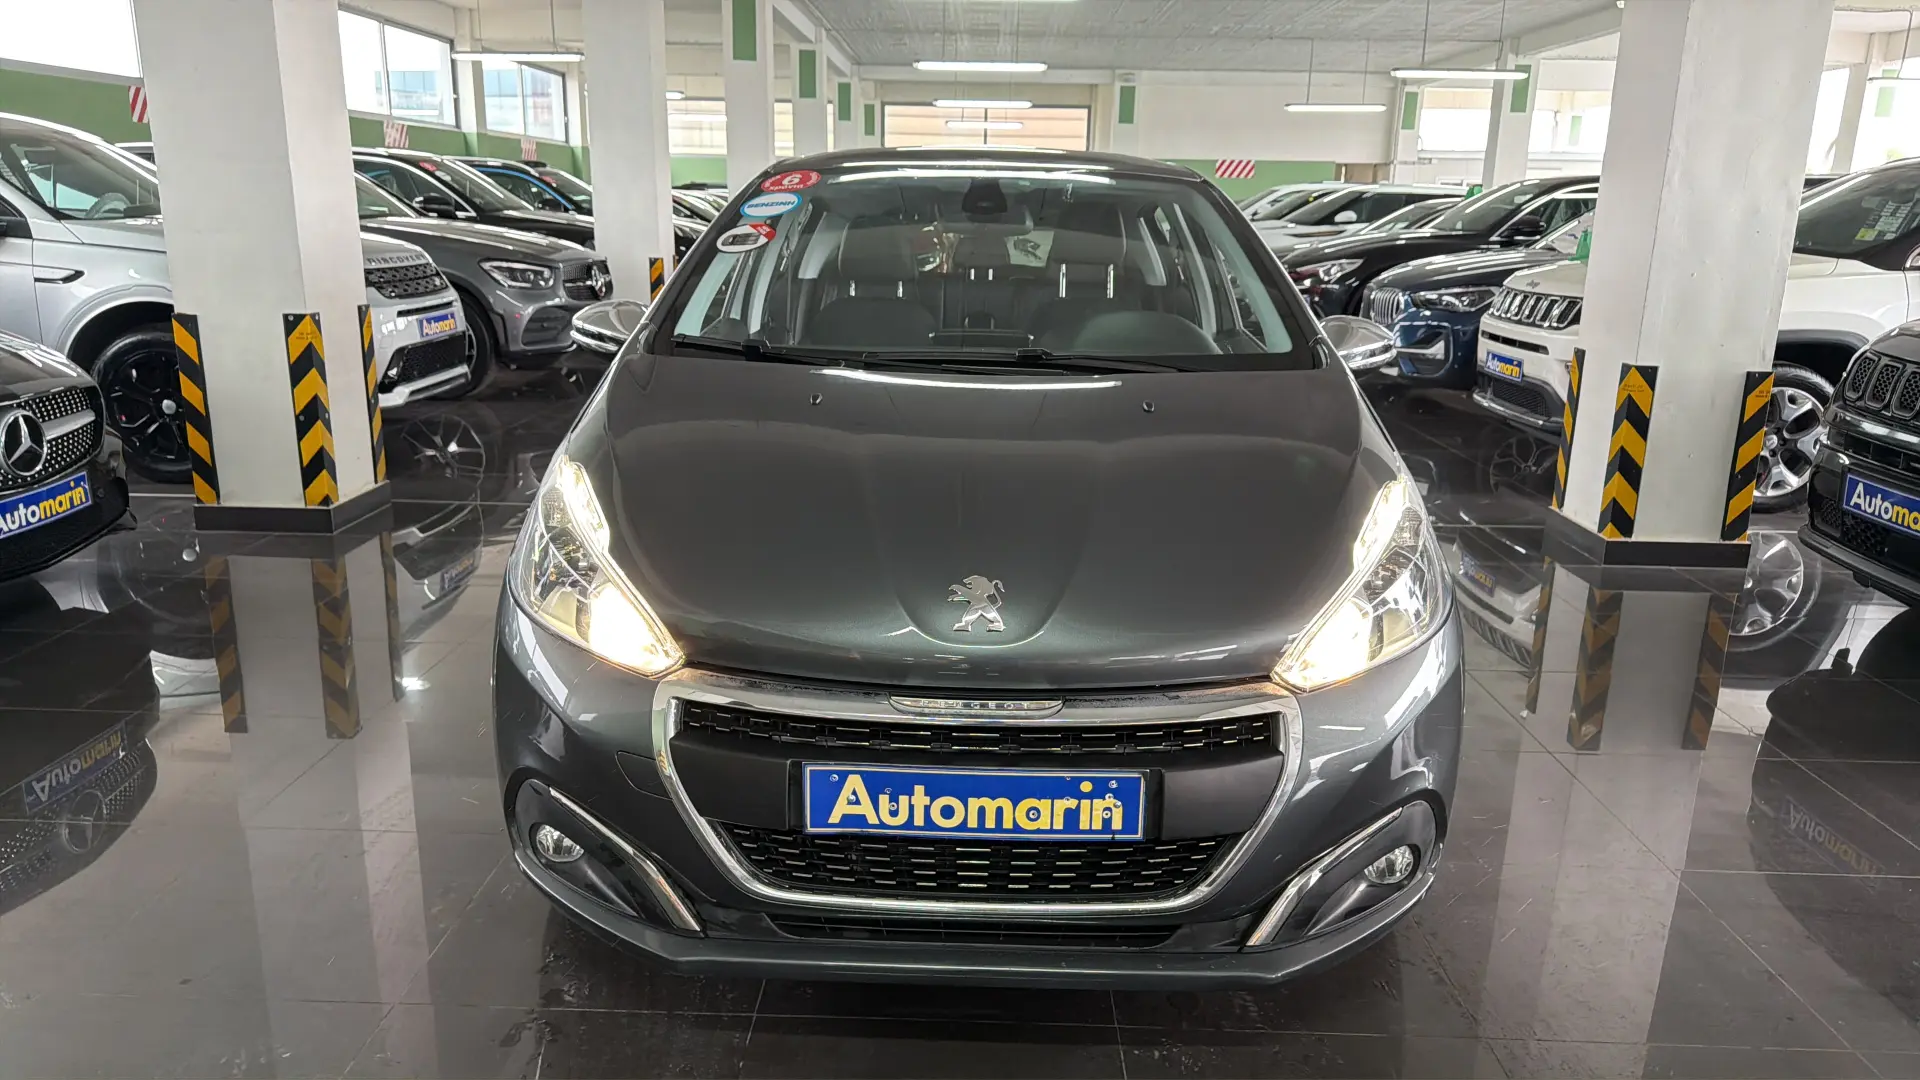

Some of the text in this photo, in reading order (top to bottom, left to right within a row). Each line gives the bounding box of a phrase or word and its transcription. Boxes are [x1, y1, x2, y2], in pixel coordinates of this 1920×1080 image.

[782, 174, 802, 185] 6
[423, 314, 456, 336] Automarin
[1486, 353, 1520, 378] Automarin
[921, 700, 1028, 709] PEUGEOT
[827, 774, 1123, 830] Automarin
